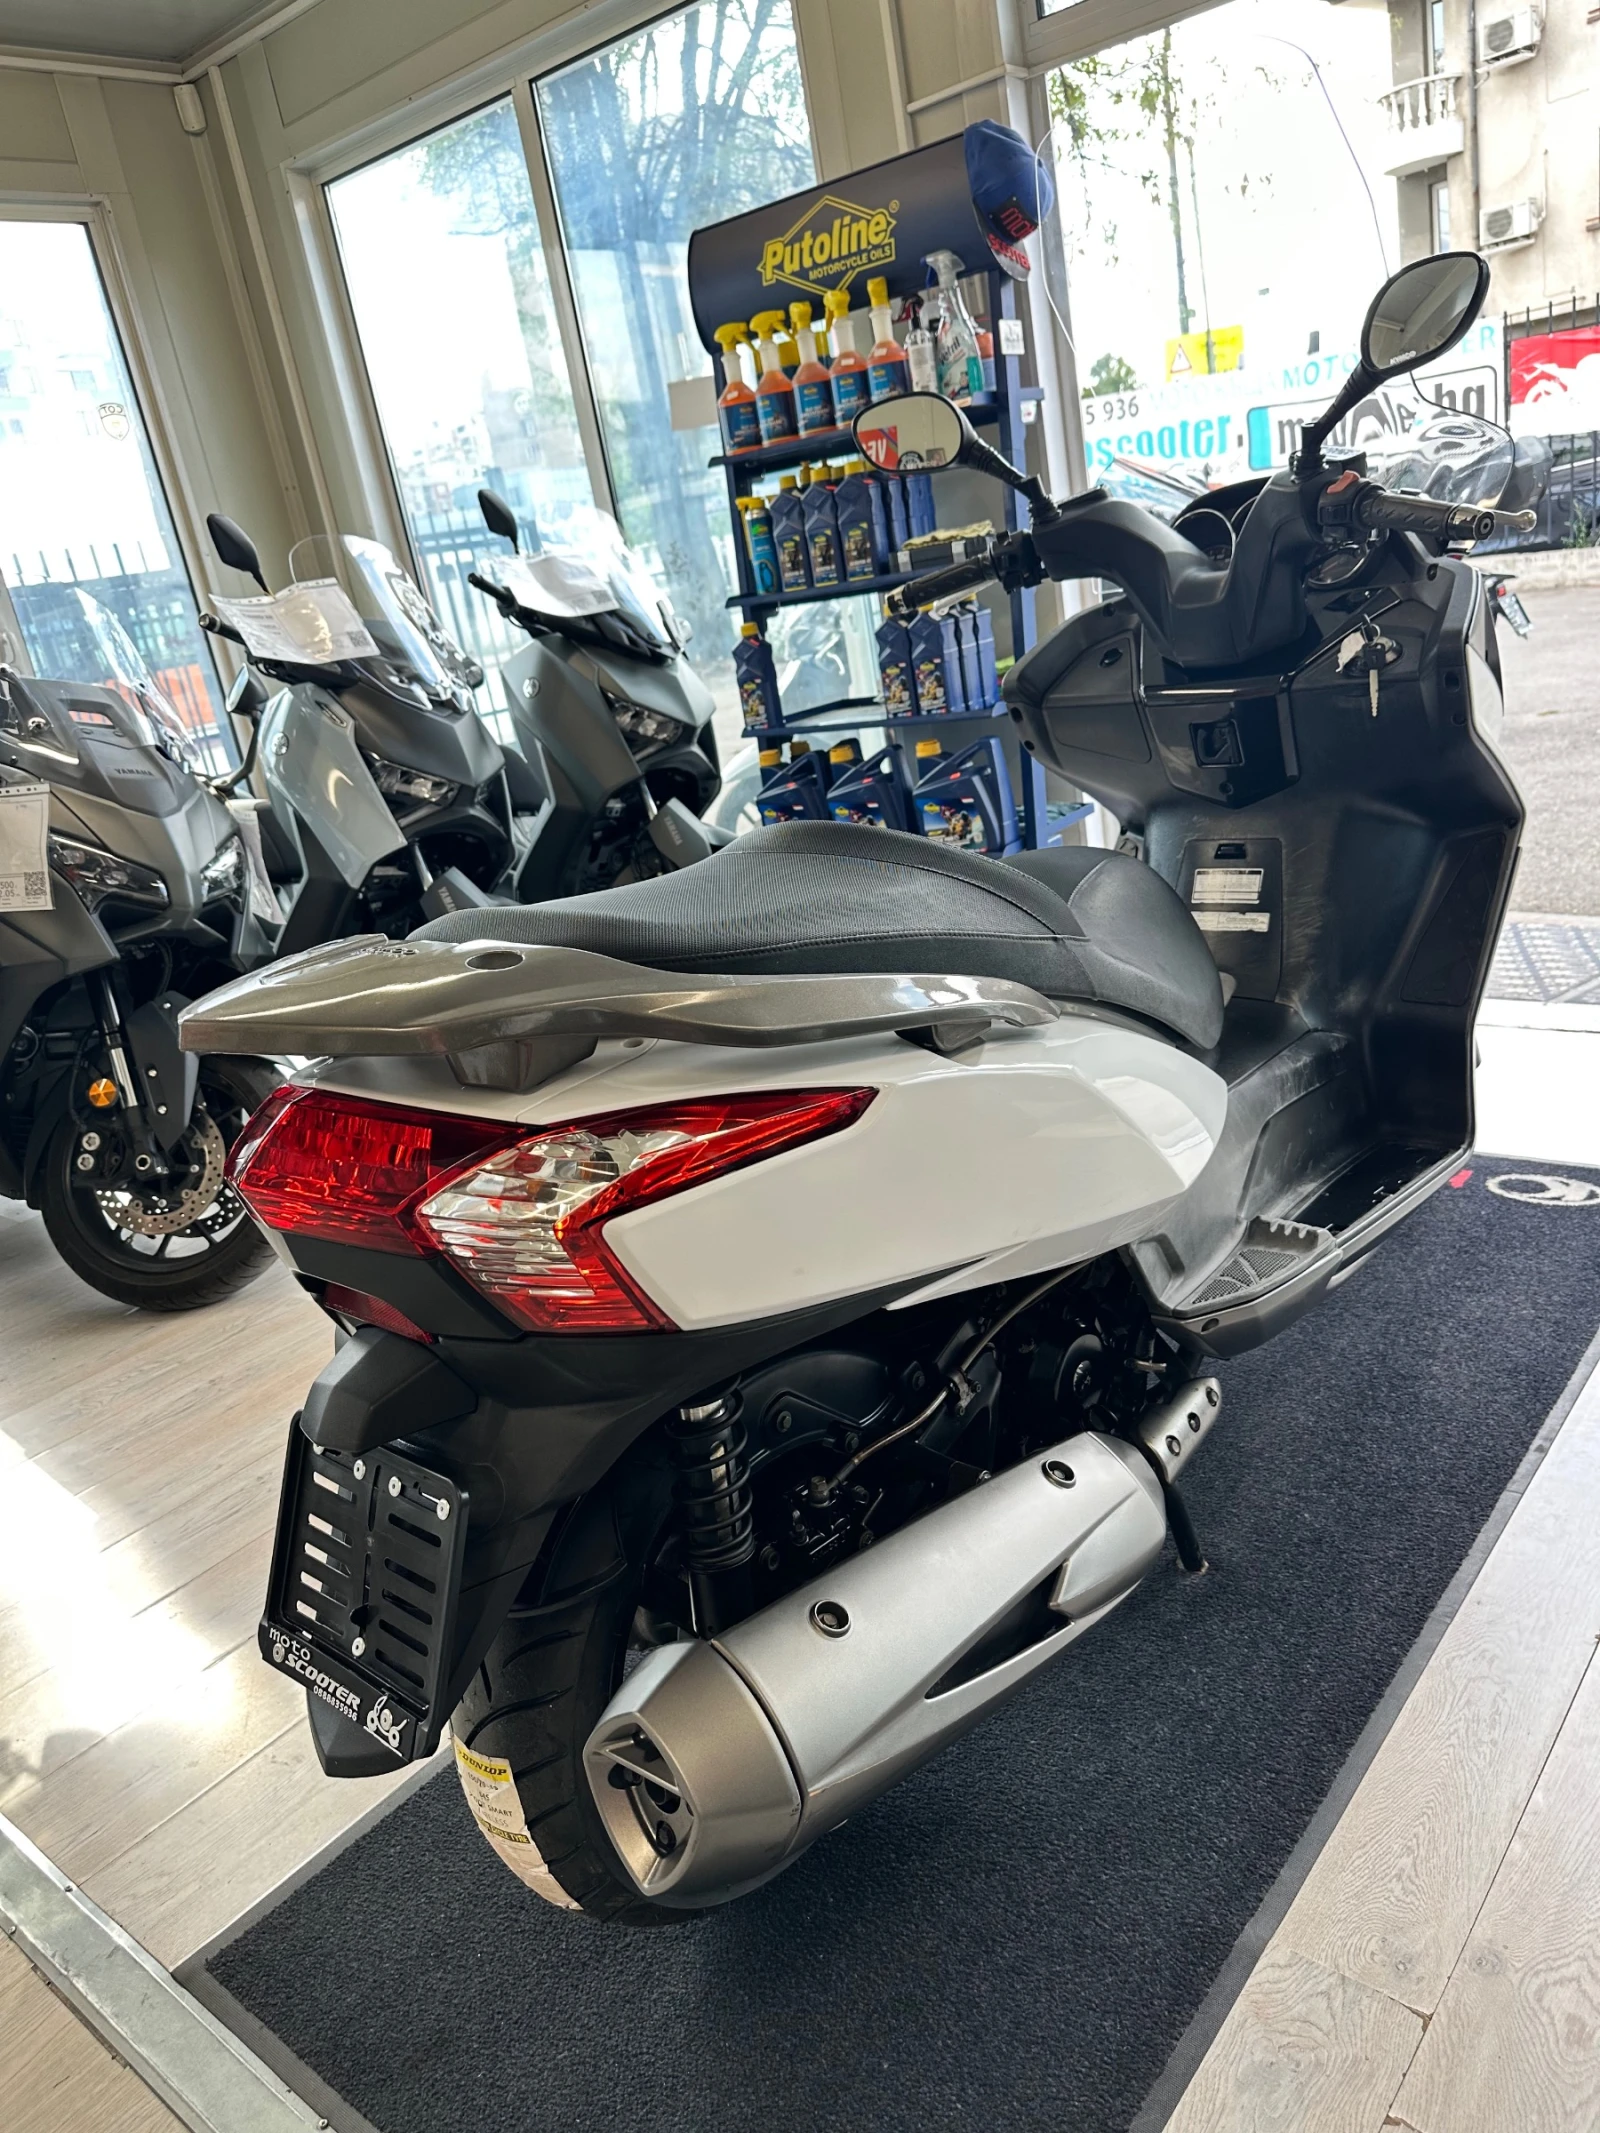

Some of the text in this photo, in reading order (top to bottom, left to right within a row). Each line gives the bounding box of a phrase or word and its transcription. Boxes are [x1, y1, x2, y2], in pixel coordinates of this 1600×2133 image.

[765, 213, 888, 281] Putoline
[808, 246, 891, 281] MOTORCYCLE OILS
[1103, 396, 1139, 422] 936
[115, 768, 154, 776] YAMAHA
[269, 1628, 311, 1661] moto
[285, 1653, 361, 1712] SCOOTER
[313, 1685, 358, 1722] 0888835936
[461, 1752, 507, 1776] DUNLOP
[487, 1804, 513, 1818] SMART
